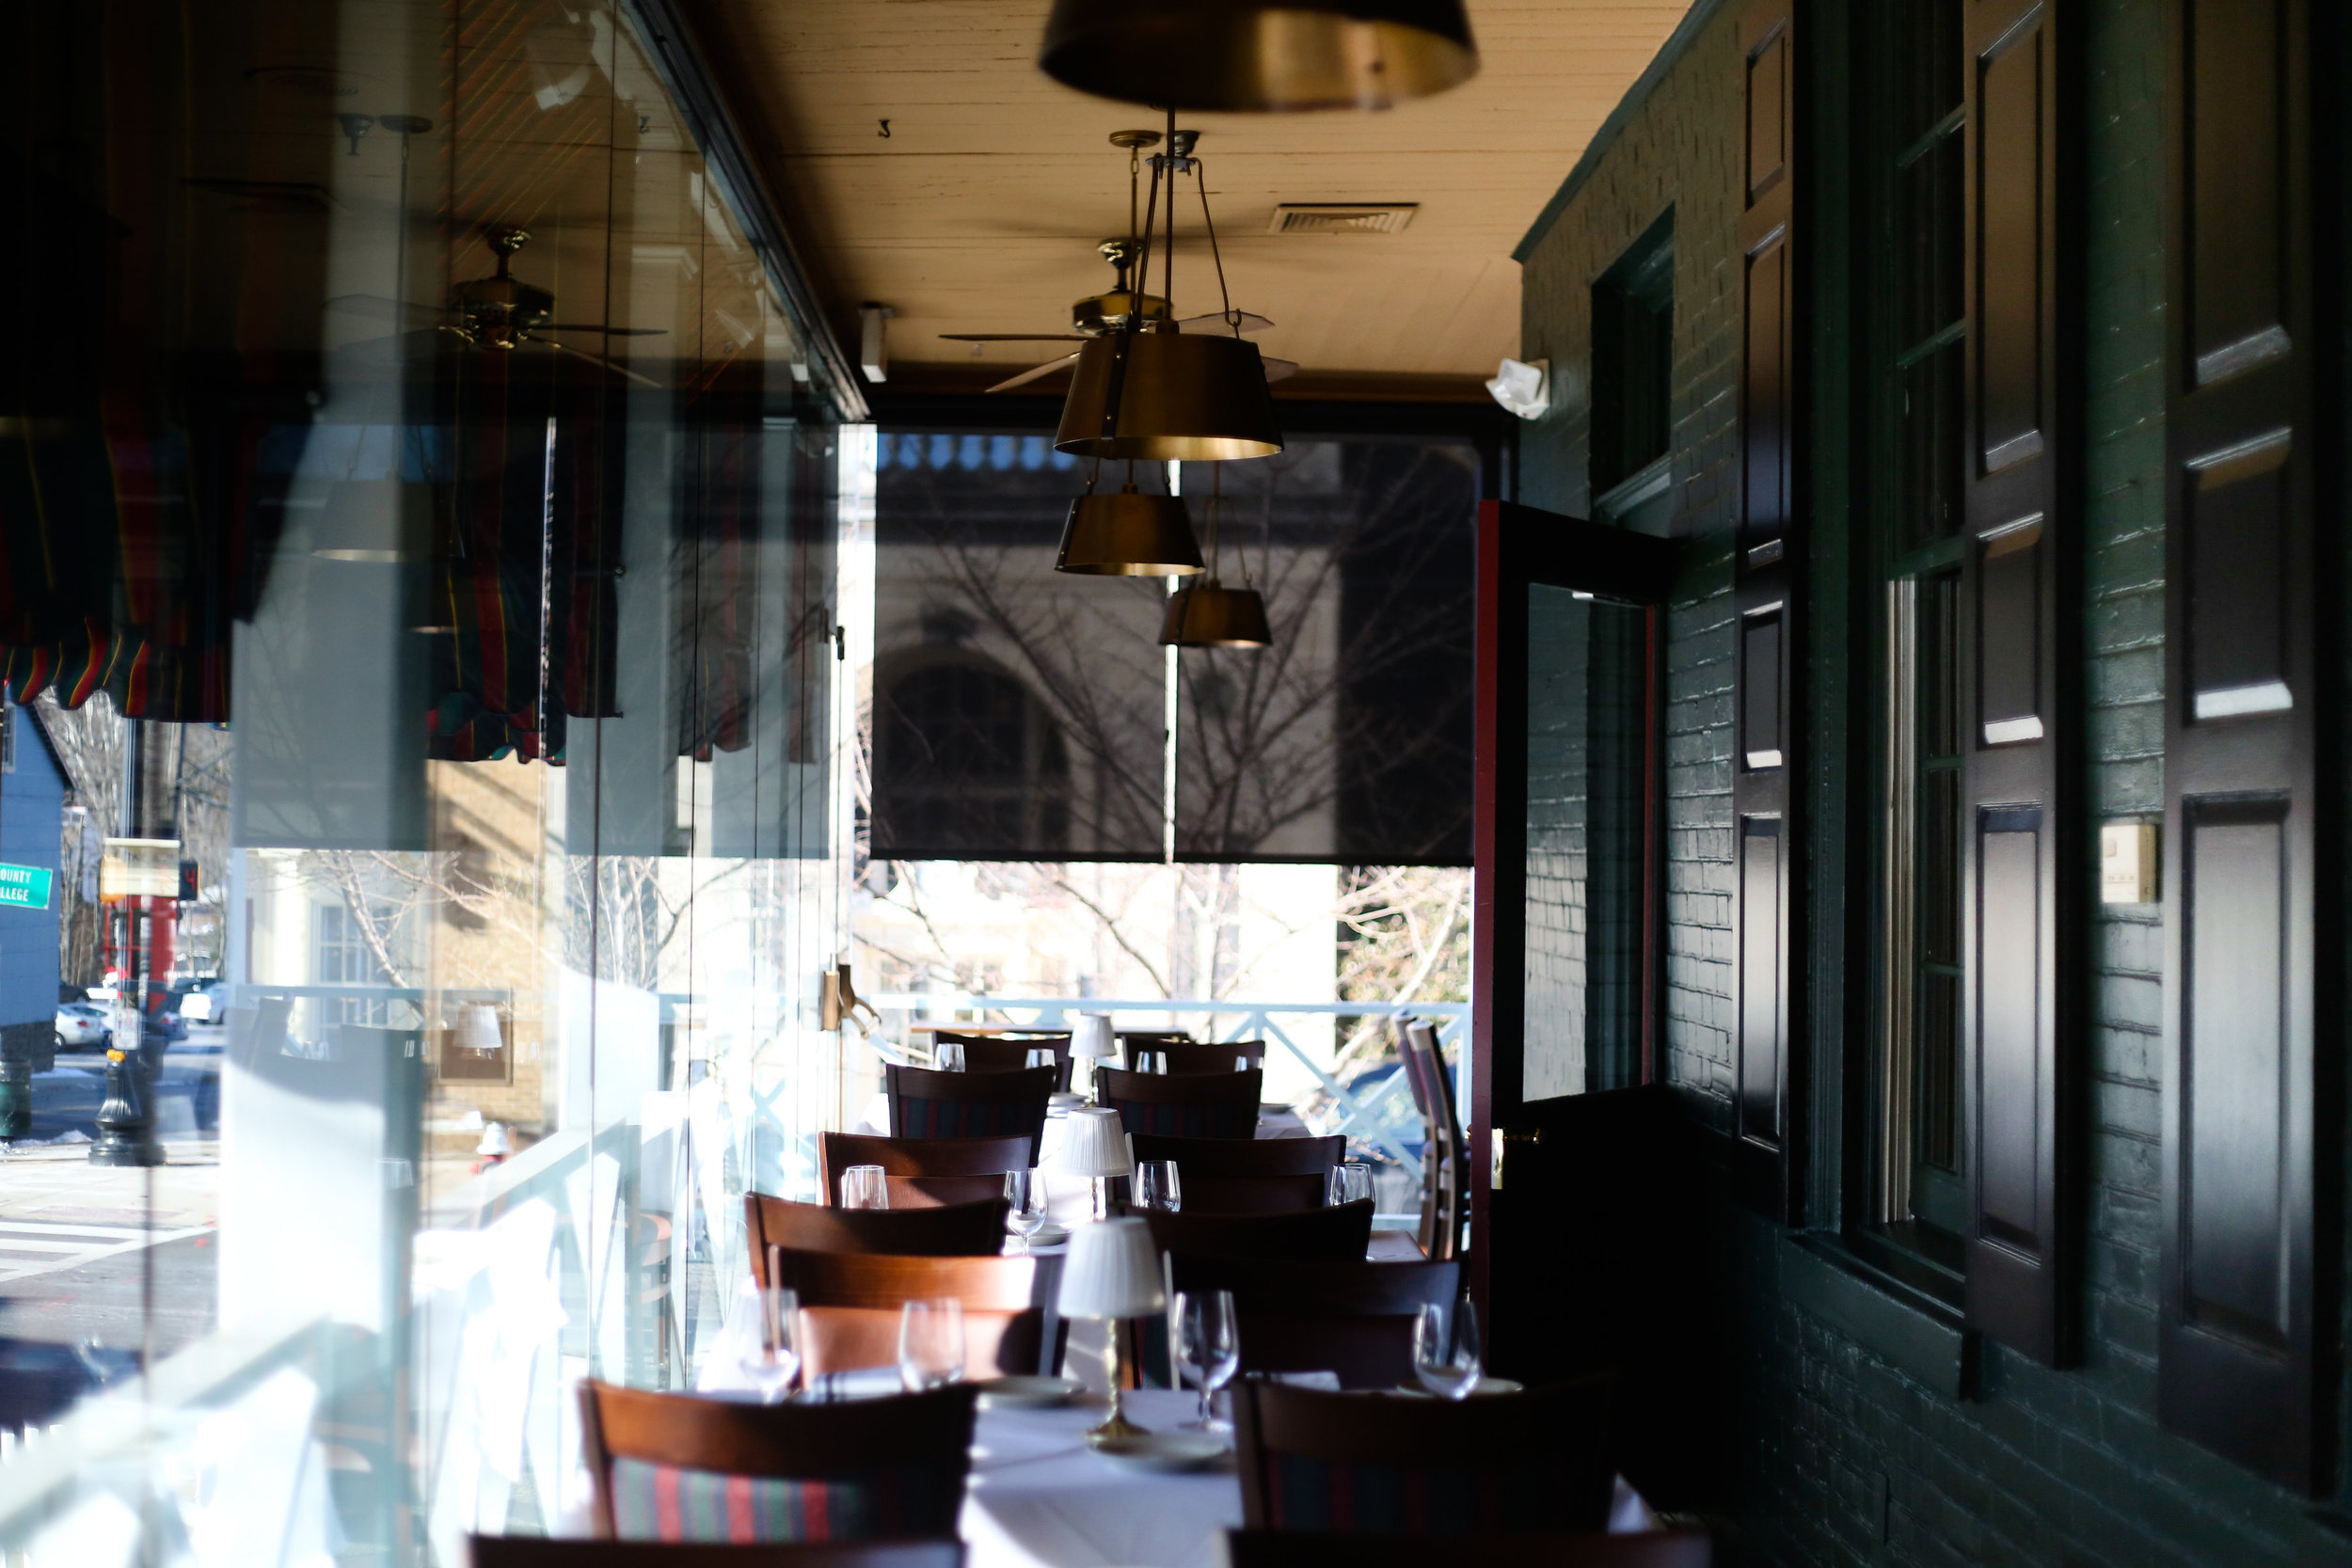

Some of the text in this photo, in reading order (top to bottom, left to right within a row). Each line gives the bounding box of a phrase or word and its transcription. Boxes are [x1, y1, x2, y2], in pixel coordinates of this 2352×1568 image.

[0, 868, 32, 884] OUNTY
[184, 869, 197, 893] 4
[0, 886, 29, 902] LLEGE
